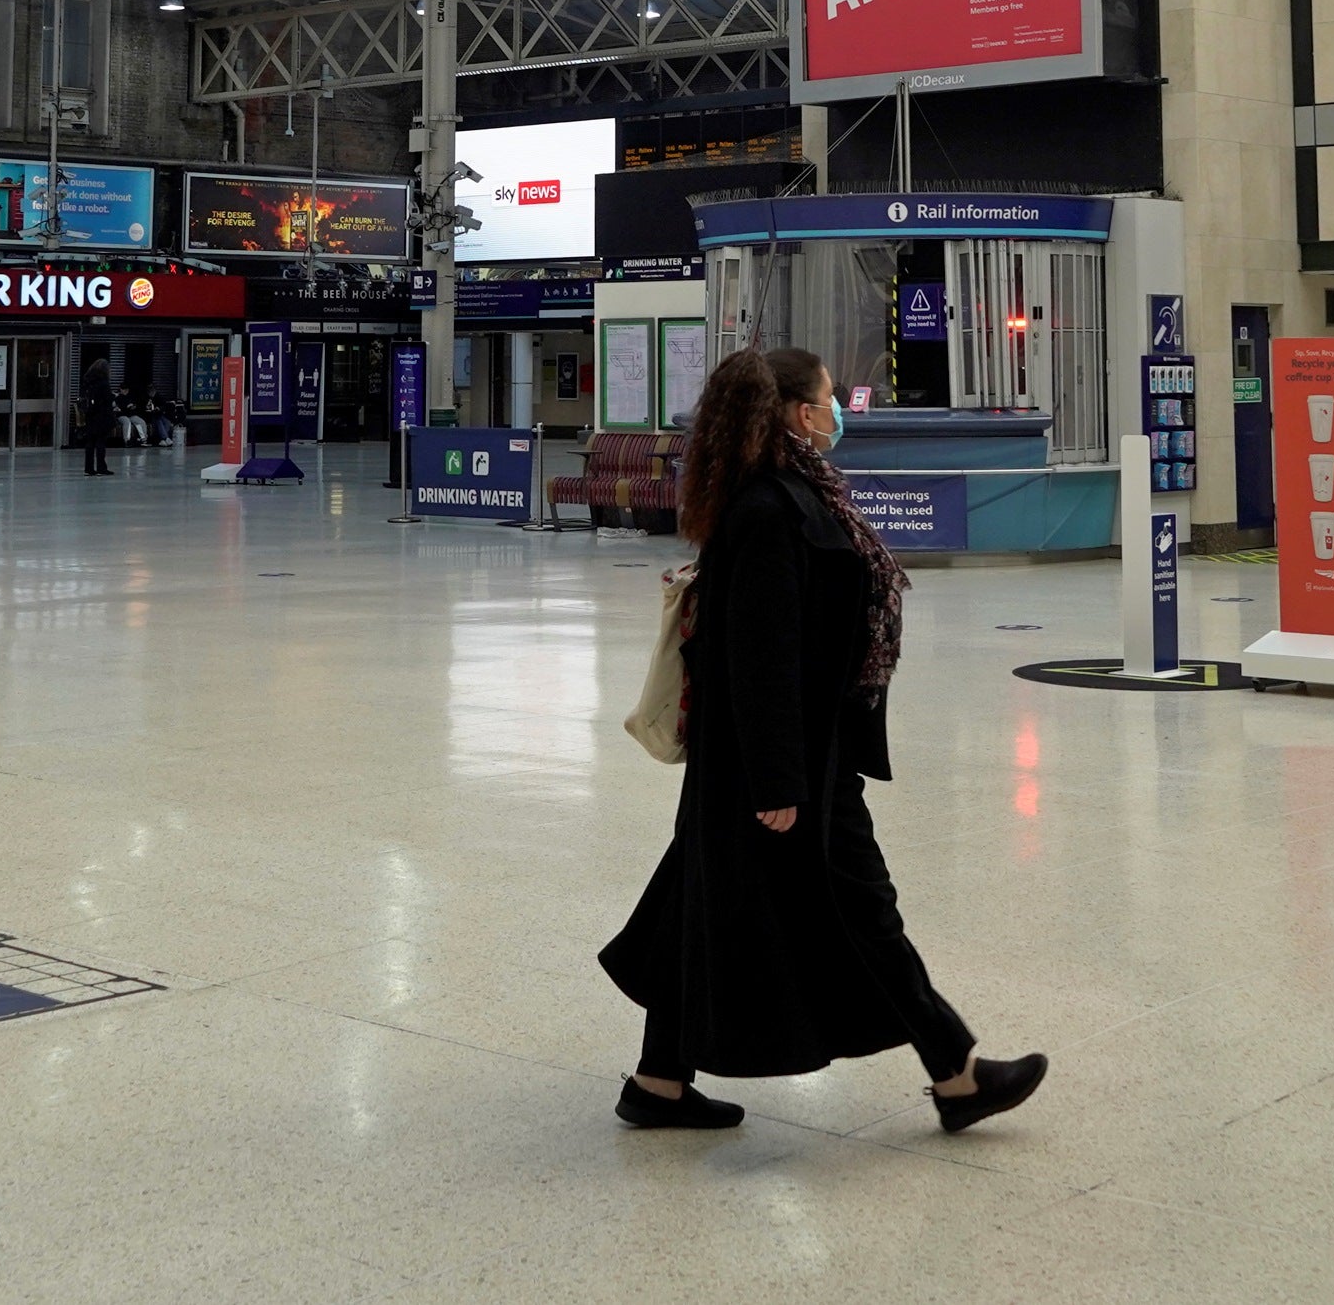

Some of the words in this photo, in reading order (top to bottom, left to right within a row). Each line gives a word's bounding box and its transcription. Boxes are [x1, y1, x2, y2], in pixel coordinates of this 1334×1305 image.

[970, 6, 999, 15] Members
[909, 74, 965, 88] JCDecaux
[79, 192, 99, 200] done
[100, 192, 131, 201] without
[494, 187, 517, 204] sky
[521, 183, 558, 200] news
[62, 202, 77, 210] like
[85, 204, 109, 213] robot.
[917, 204, 946, 219] Rail
[951, 204, 1039, 220] information
[212, 210, 226, 219] THE
[227, 211, 252, 219] DESIRE
[224, 219, 256, 227] REVENGE
[623, 258, 657, 268] DRINKING
[659, 258, 682, 266] WATER
[20, 274, 112, 309] KING
[132, 289, 151, 301] KING
[299, 289, 317, 298] THE
[323, 290, 347, 299] BEER
[352, 291, 387, 300] HOUSE
[1291, 359, 1324, 369] Recycle
[1315, 375, 1331, 383] cup
[418, 487, 477, 505] DRINKING
[480, 490, 524, 507] WATER
[851, 490, 873, 499] Face
[876, 491, 929, 502] coverings
[889, 505, 903, 515] be
[906, 505, 933, 515] used
[888, 520, 933, 530] services
[1154, 570, 1175, 579] sanitiser
[1154, 581, 1176, 591] available
[1159, 594, 1171, 602] here
